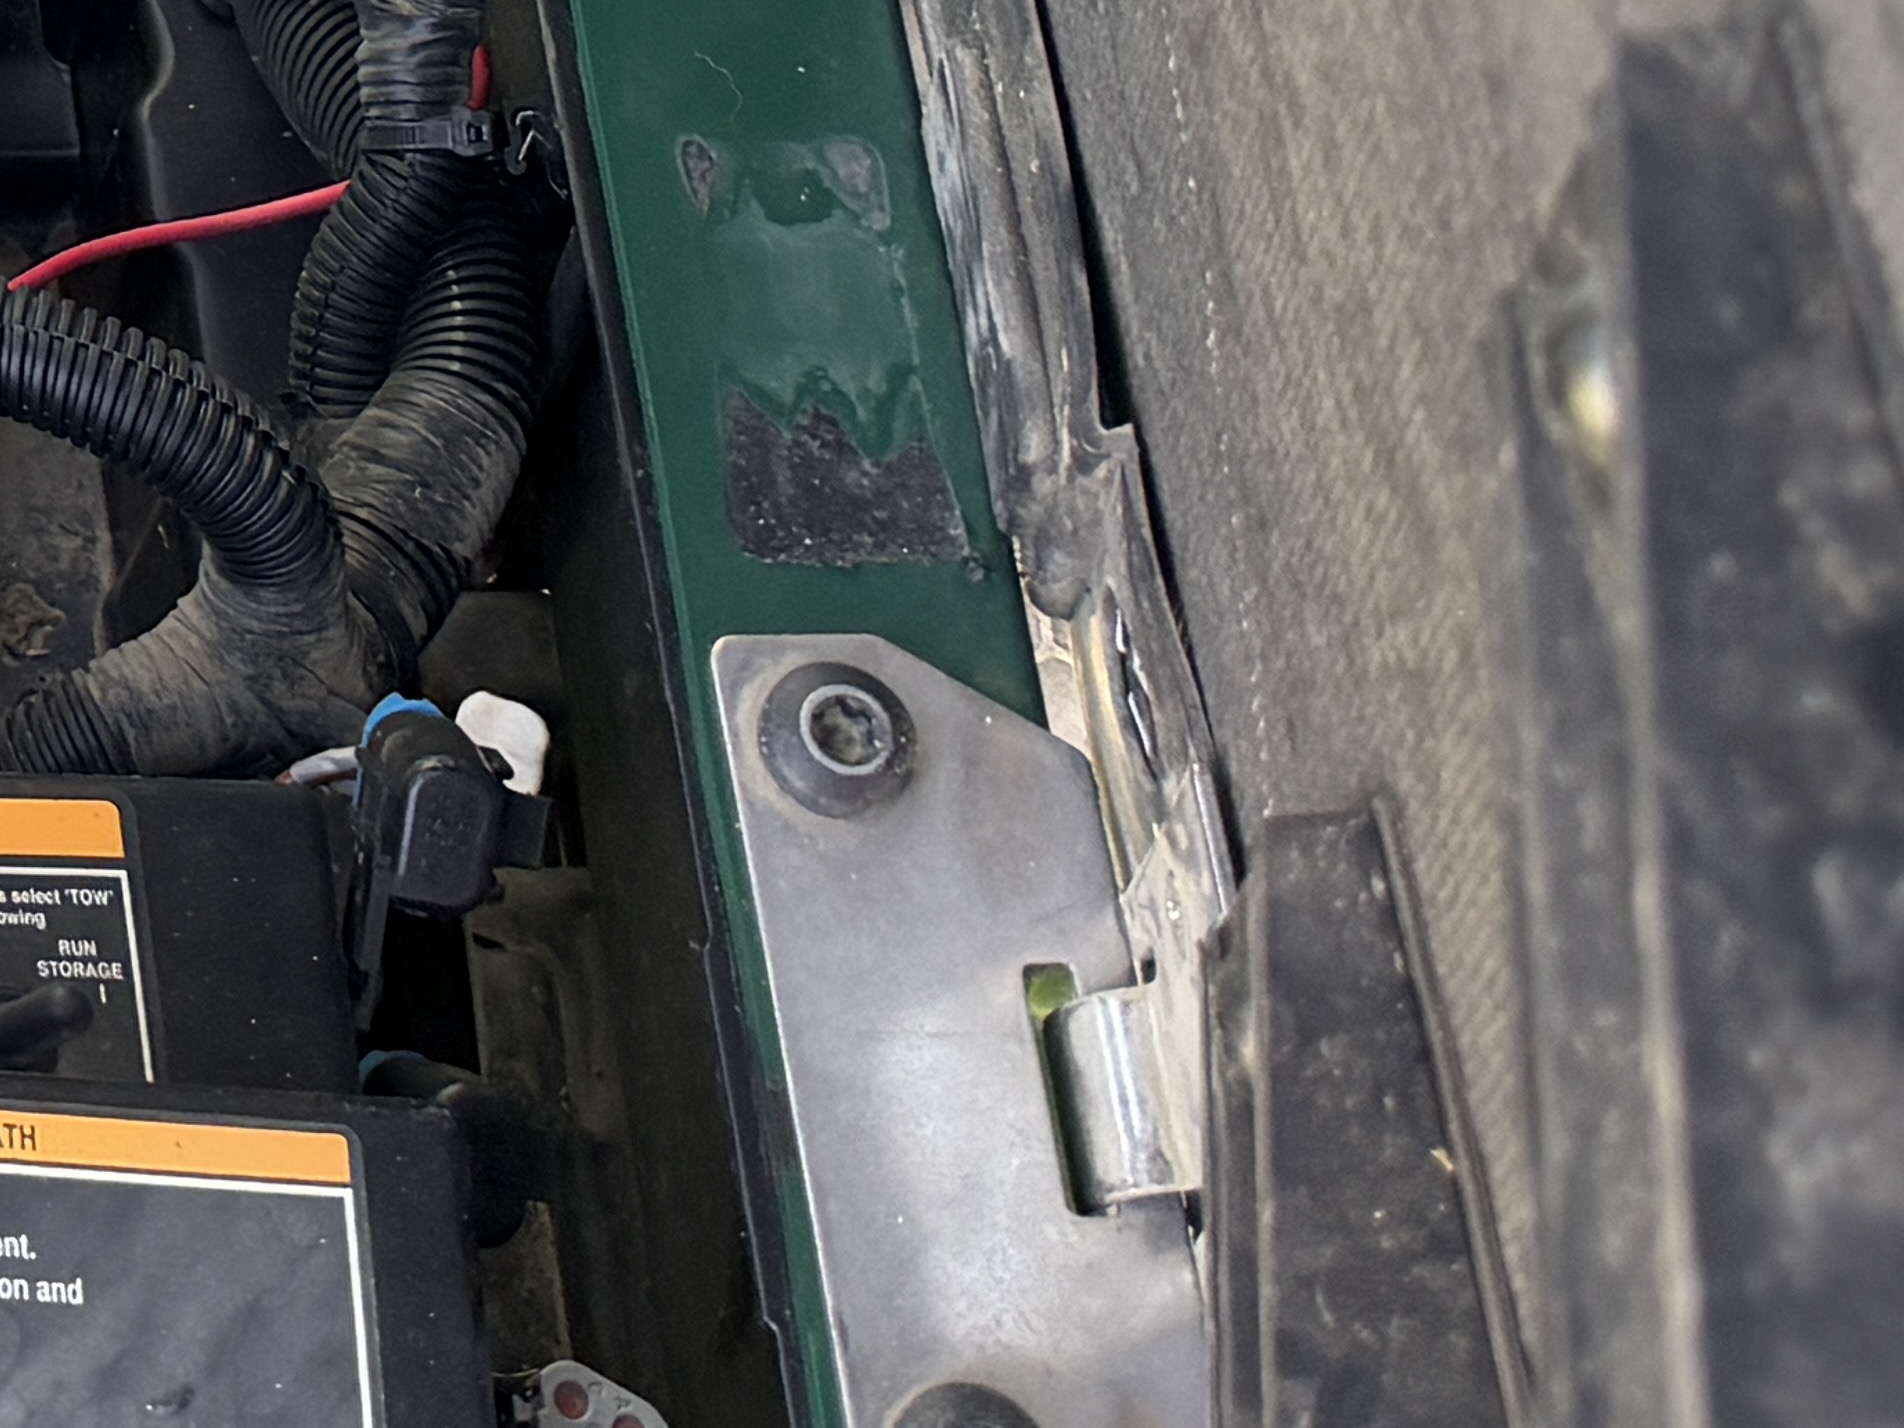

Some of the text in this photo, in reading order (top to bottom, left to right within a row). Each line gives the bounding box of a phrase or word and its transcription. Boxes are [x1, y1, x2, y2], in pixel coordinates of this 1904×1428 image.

[12, 888, 61, 904] select
[65, 889, 113, 905] 'TOW'
[58, 940, 96, 955] RUN
[37, 960, 123, 979] STORAGE
[36, 1278, 84, 1305] and
